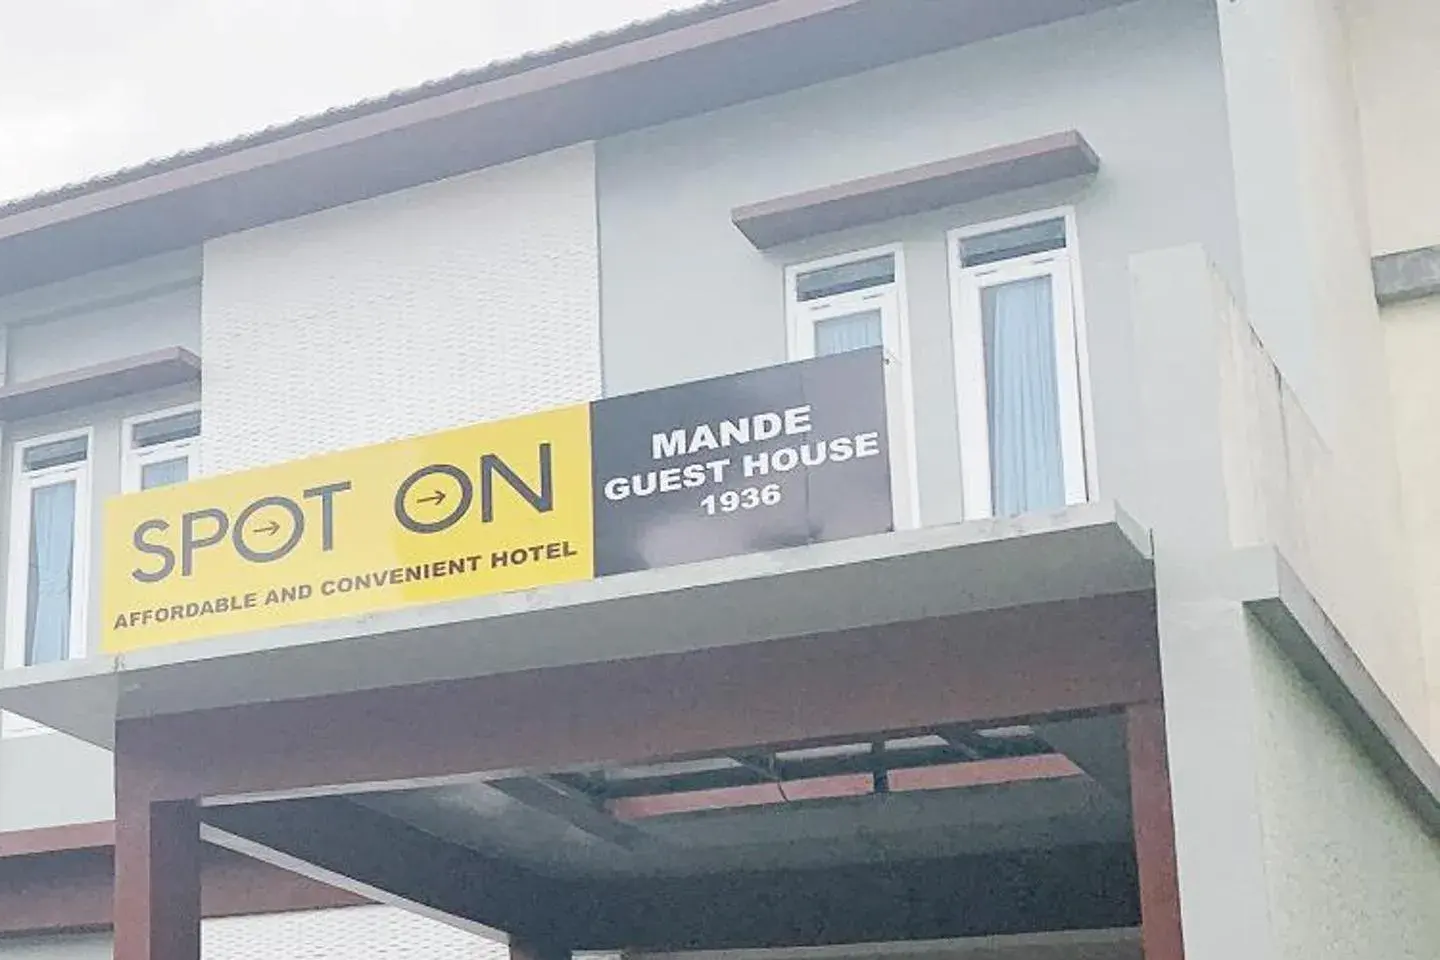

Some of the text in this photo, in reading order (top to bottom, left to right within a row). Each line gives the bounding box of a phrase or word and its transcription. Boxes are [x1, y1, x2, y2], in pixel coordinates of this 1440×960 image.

[603, 431, 881, 501] GUEST HOUSE
[652, 404, 813, 460] MANDE
[132, 442, 554, 583] SPOT ON
[700, 483, 782, 516] 1936
[113, 541, 578, 631] AFFORDABLE AND CONVENIENT HOTEL
